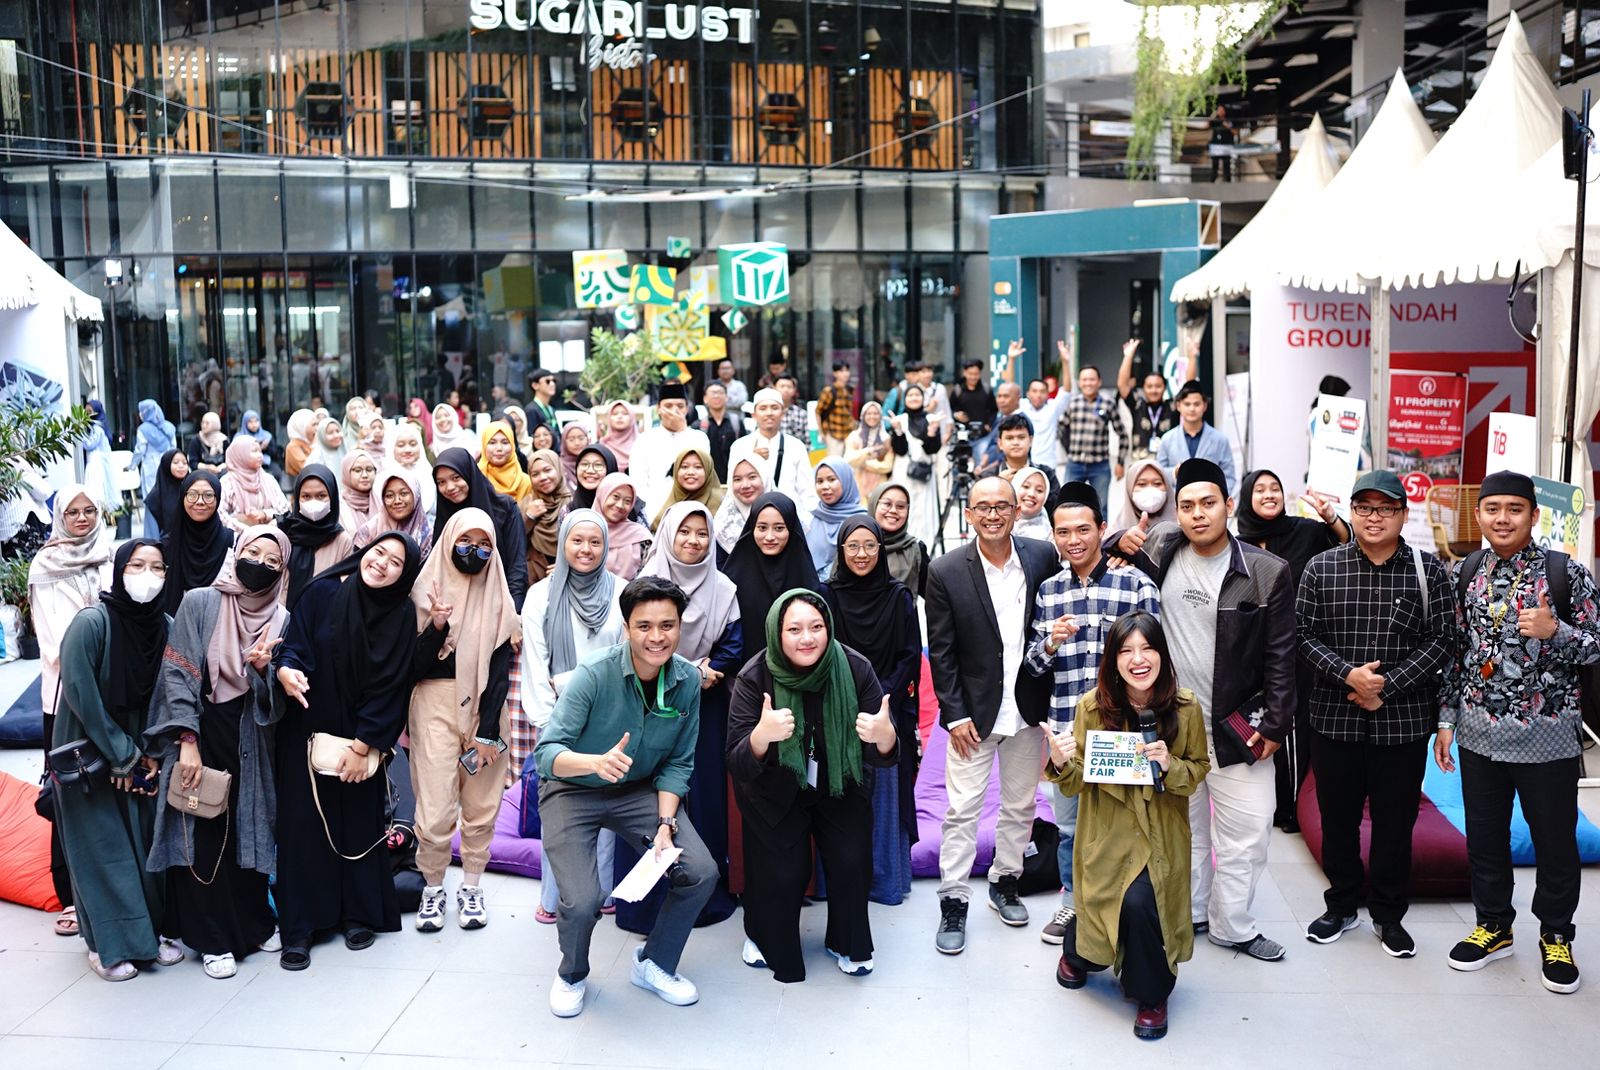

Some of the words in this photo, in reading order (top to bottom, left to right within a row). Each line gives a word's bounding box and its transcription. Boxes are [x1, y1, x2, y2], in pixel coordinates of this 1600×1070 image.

[469, 0, 760, 43] SUGARLUST
[1288, 302, 1371, 322] TUREN
[1390, 302, 1457, 322] NDAH
[1405, 397, 1460, 408] PROPERTY
[1187, 588, 1208, 599] WORLD
[1091, 758, 1134, 767] CAREER
[1090, 768, 1115, 776] FAIR
